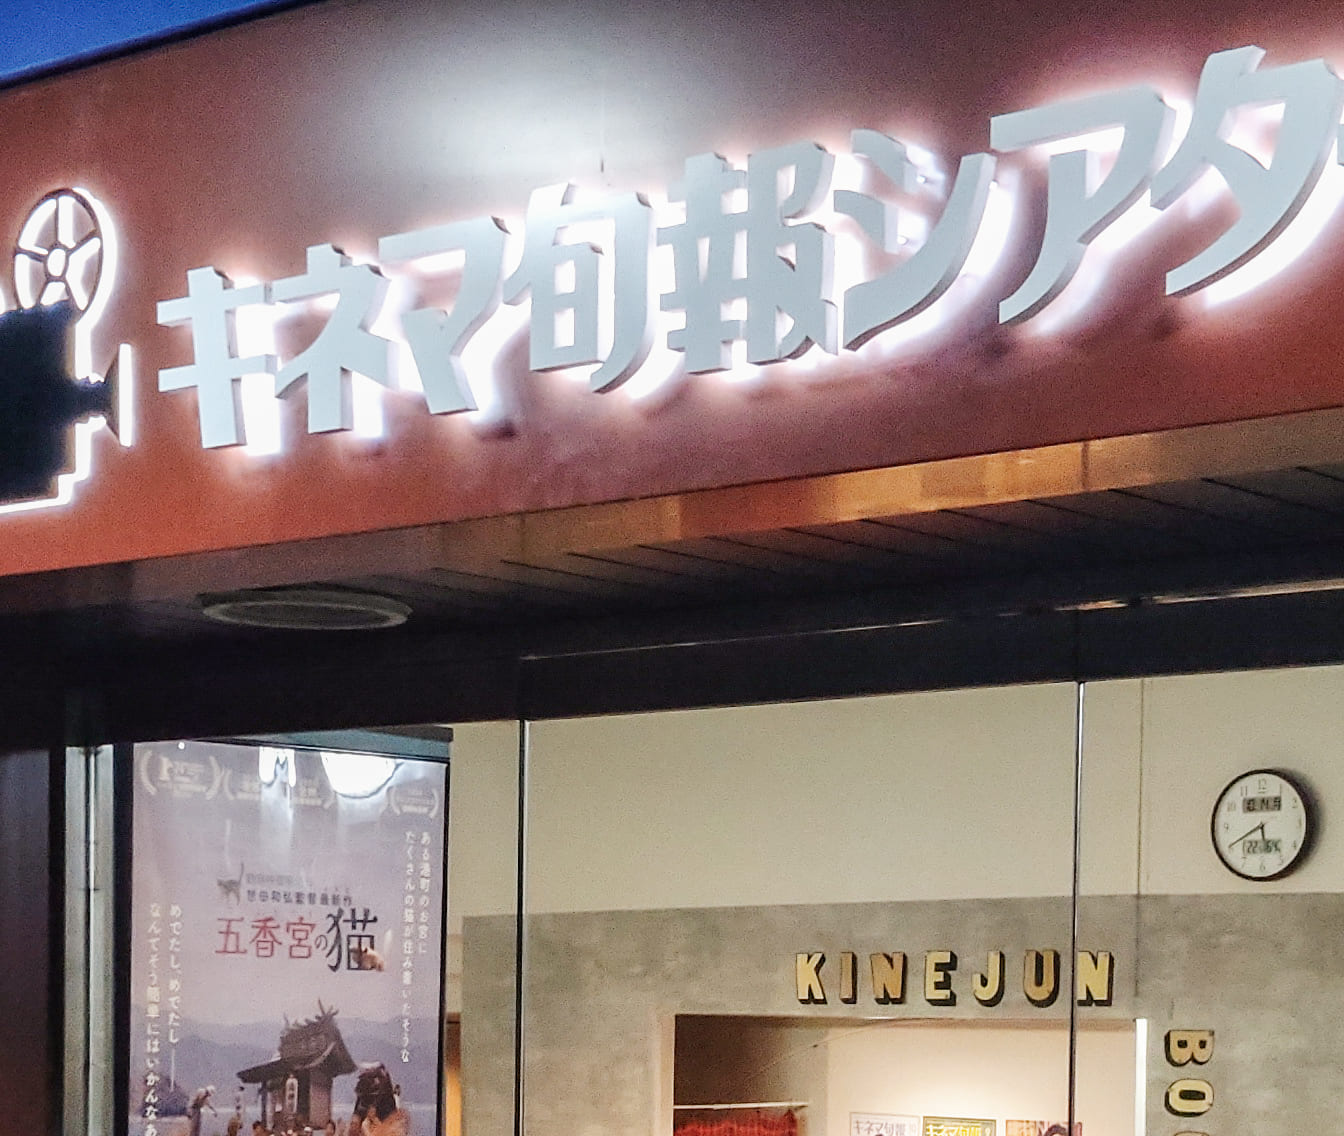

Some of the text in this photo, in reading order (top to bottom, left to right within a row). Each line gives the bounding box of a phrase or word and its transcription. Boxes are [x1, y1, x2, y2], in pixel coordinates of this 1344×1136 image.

[214, 907, 378, 973] 五香宮の猫
[795, 949, 1115, 1006] KINEJUN
[852, 1119, 906, 1136] キネマ旬報
